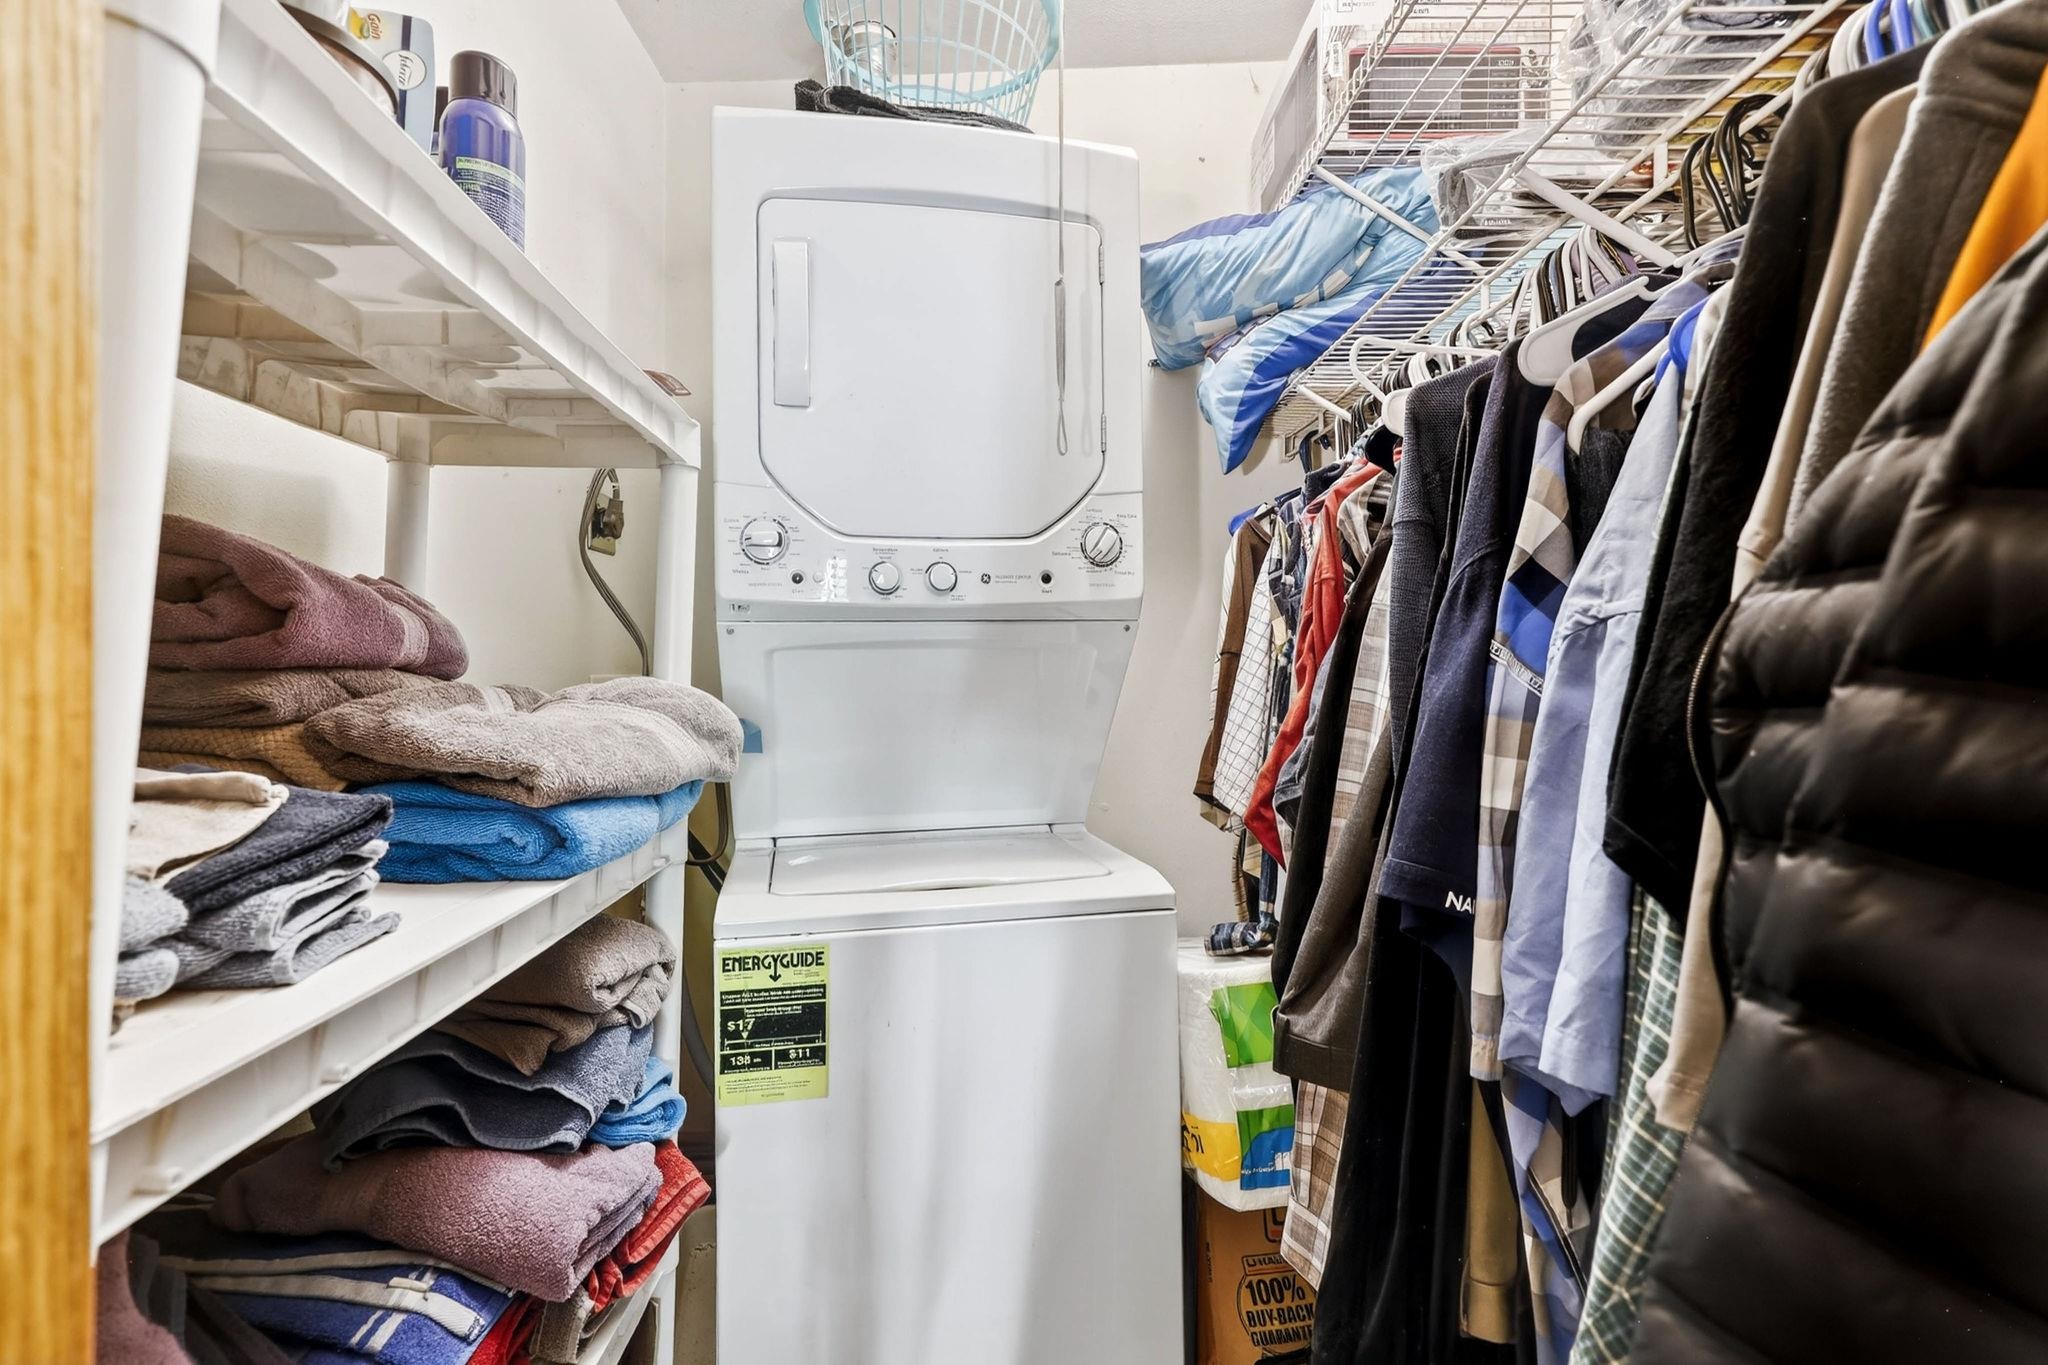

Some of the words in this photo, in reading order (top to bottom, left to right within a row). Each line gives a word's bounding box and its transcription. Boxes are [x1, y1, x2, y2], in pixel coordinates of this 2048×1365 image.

[368, 13, 382, 40] Gain
[722, 951, 825, 974] ENERGYGUIDE
[727, 1017, 756, 1032] $17
[789, 1048, 811, 1060] $11
[1245, 1273, 1306, 1306] 100%
[1250, 1324, 1313, 1347] GUARANTE
